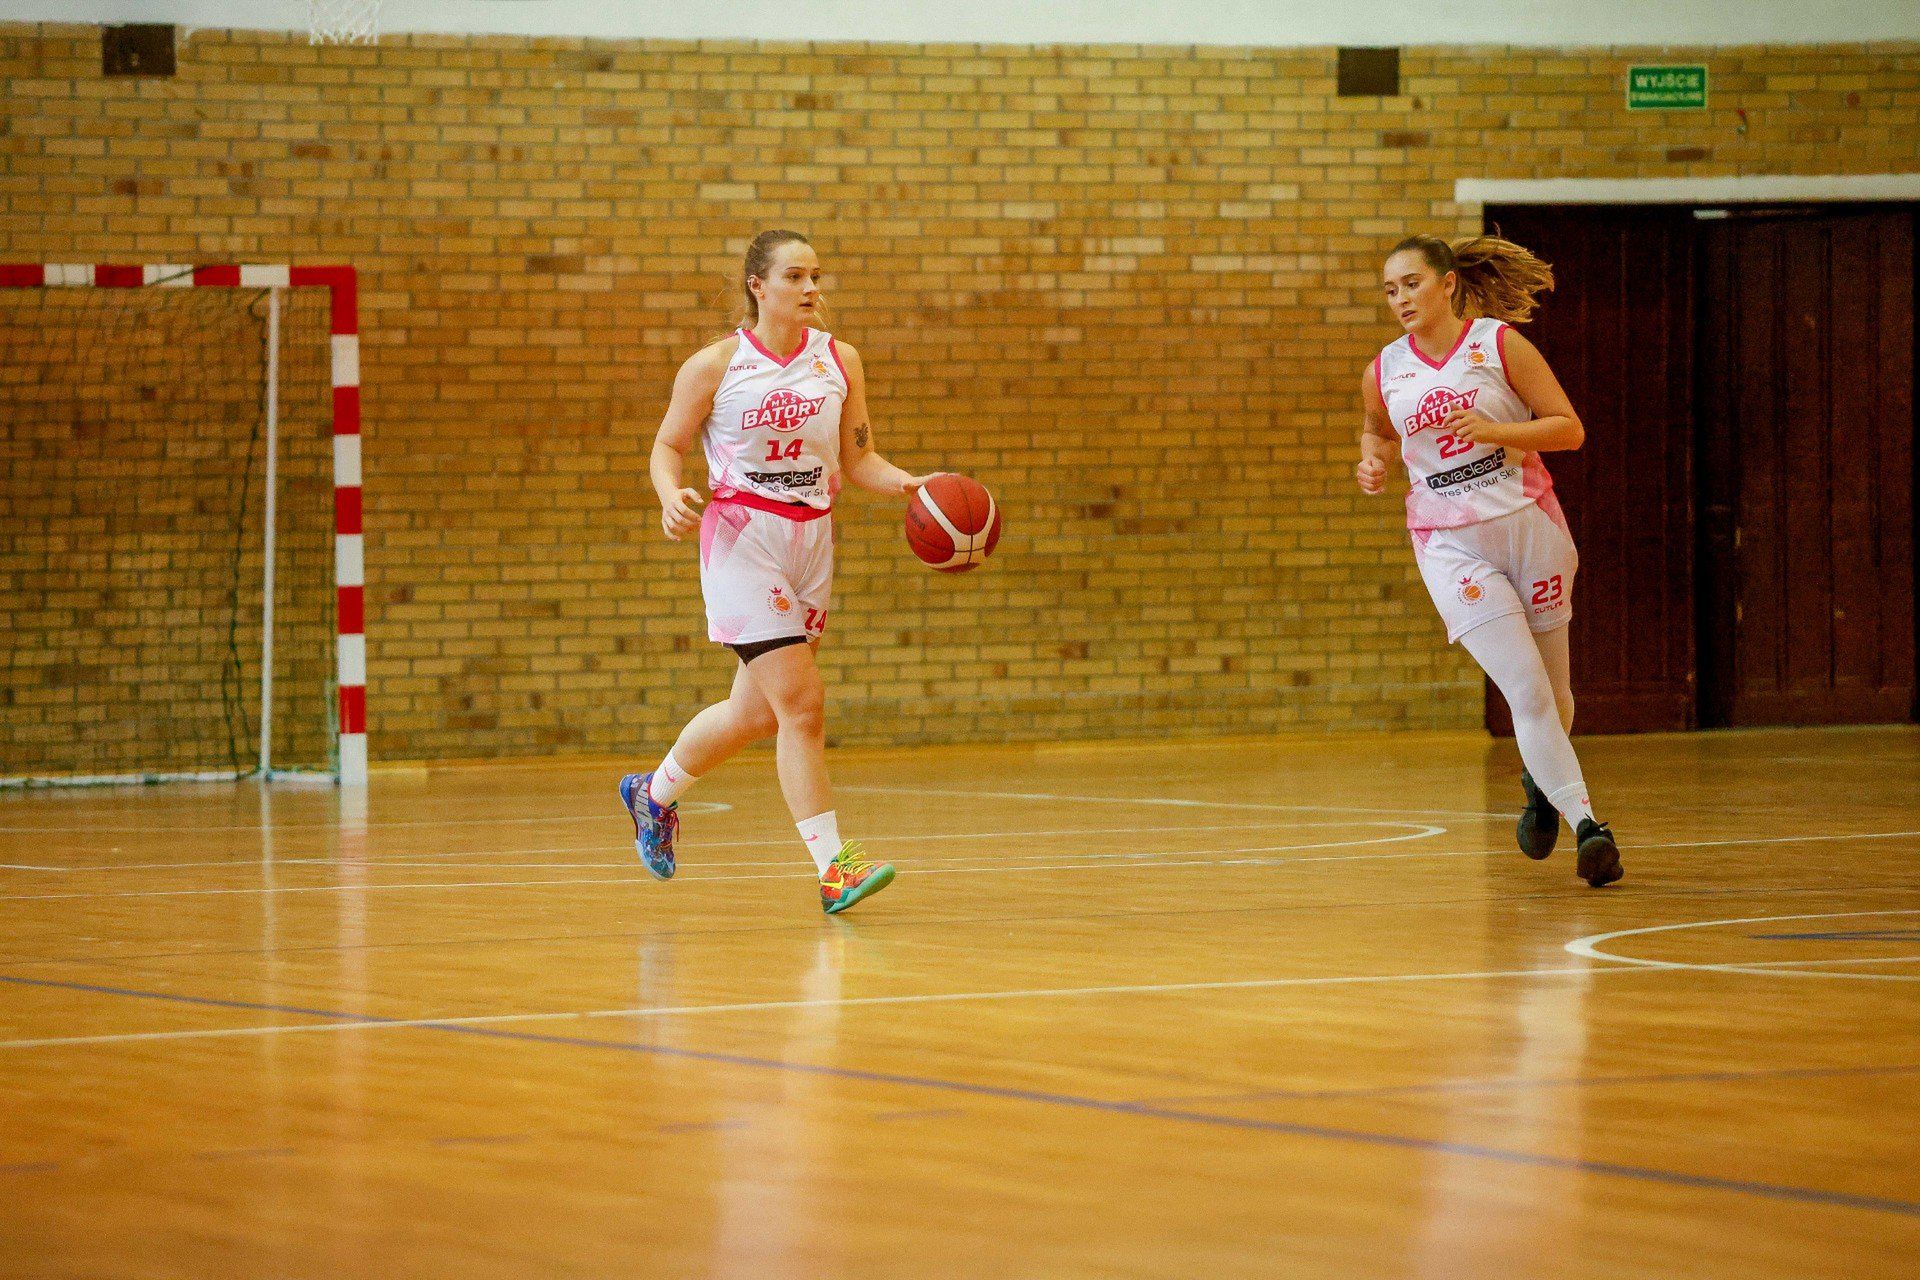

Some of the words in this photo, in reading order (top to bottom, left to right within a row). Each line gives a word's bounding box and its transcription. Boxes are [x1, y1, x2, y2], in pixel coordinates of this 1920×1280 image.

[771, 396, 797, 407] MKS
[1426, 394, 1449, 410] MKS
[744, 398, 824, 427] BATORY
[765, 438, 803, 461] 14
[1474, 475, 1499, 489] Your
[1532, 575, 1562, 605] 23
